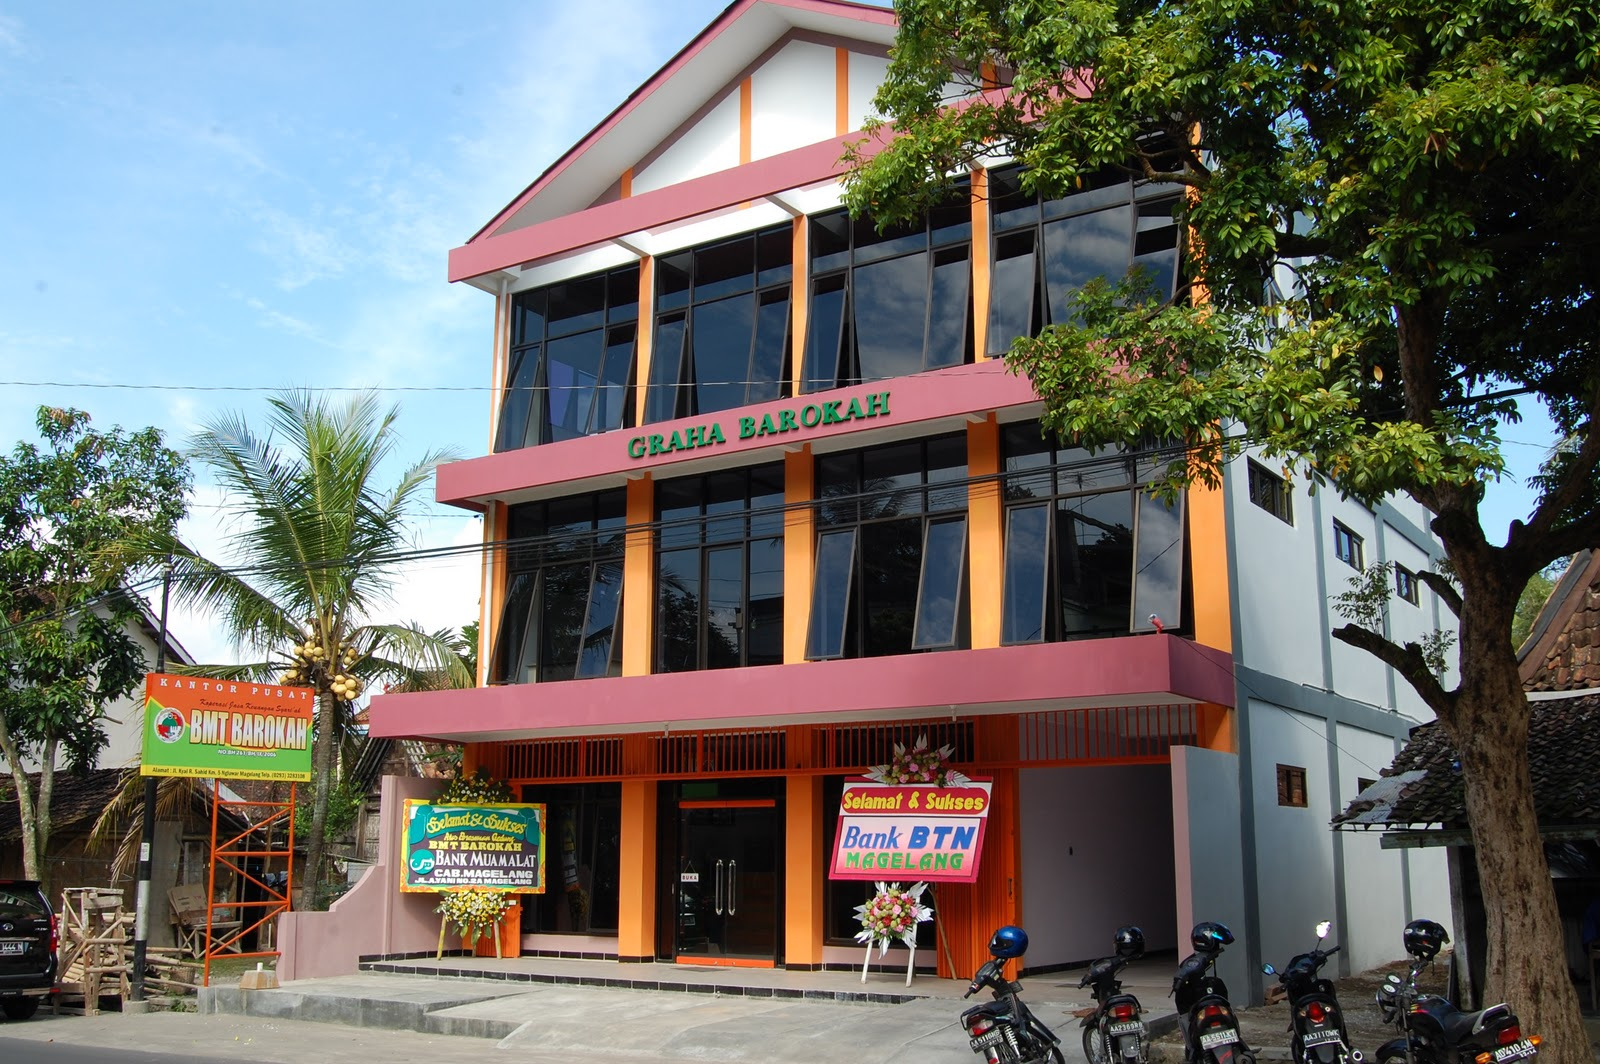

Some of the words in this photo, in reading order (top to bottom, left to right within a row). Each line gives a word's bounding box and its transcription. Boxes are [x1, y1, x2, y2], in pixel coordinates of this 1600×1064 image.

[628, 423, 726, 458] GRAHA
[739, 391, 890, 439] BAROKAH
[160, 678, 237, 692] KANTOR
[252, 687, 307, 699] PUSAT
[200, 699, 227, 707] Koperasi
[245, 703, 274, 713] Keuangan
[189, 709, 229, 745] BMT
[230, 712, 308, 750] BAROKAH
[844, 792, 903, 810] Selamat
[908, 791, 920, 809] &
[926, 792, 984, 811] Sukses
[426, 812, 470, 834] Selamat
[470, 814, 482, 827] &
[483, 813, 527, 834] Sukses
[429, 841, 458, 850] BMT
[460, 841, 522, 851] BAROKAH
[842, 826, 902, 849] Bank
[907, 826, 976, 850] BTN
[435, 850, 468, 866] BANK
[470, 851, 536, 868] MUAMALAT
[845, 852, 964, 871] MAGELANG
